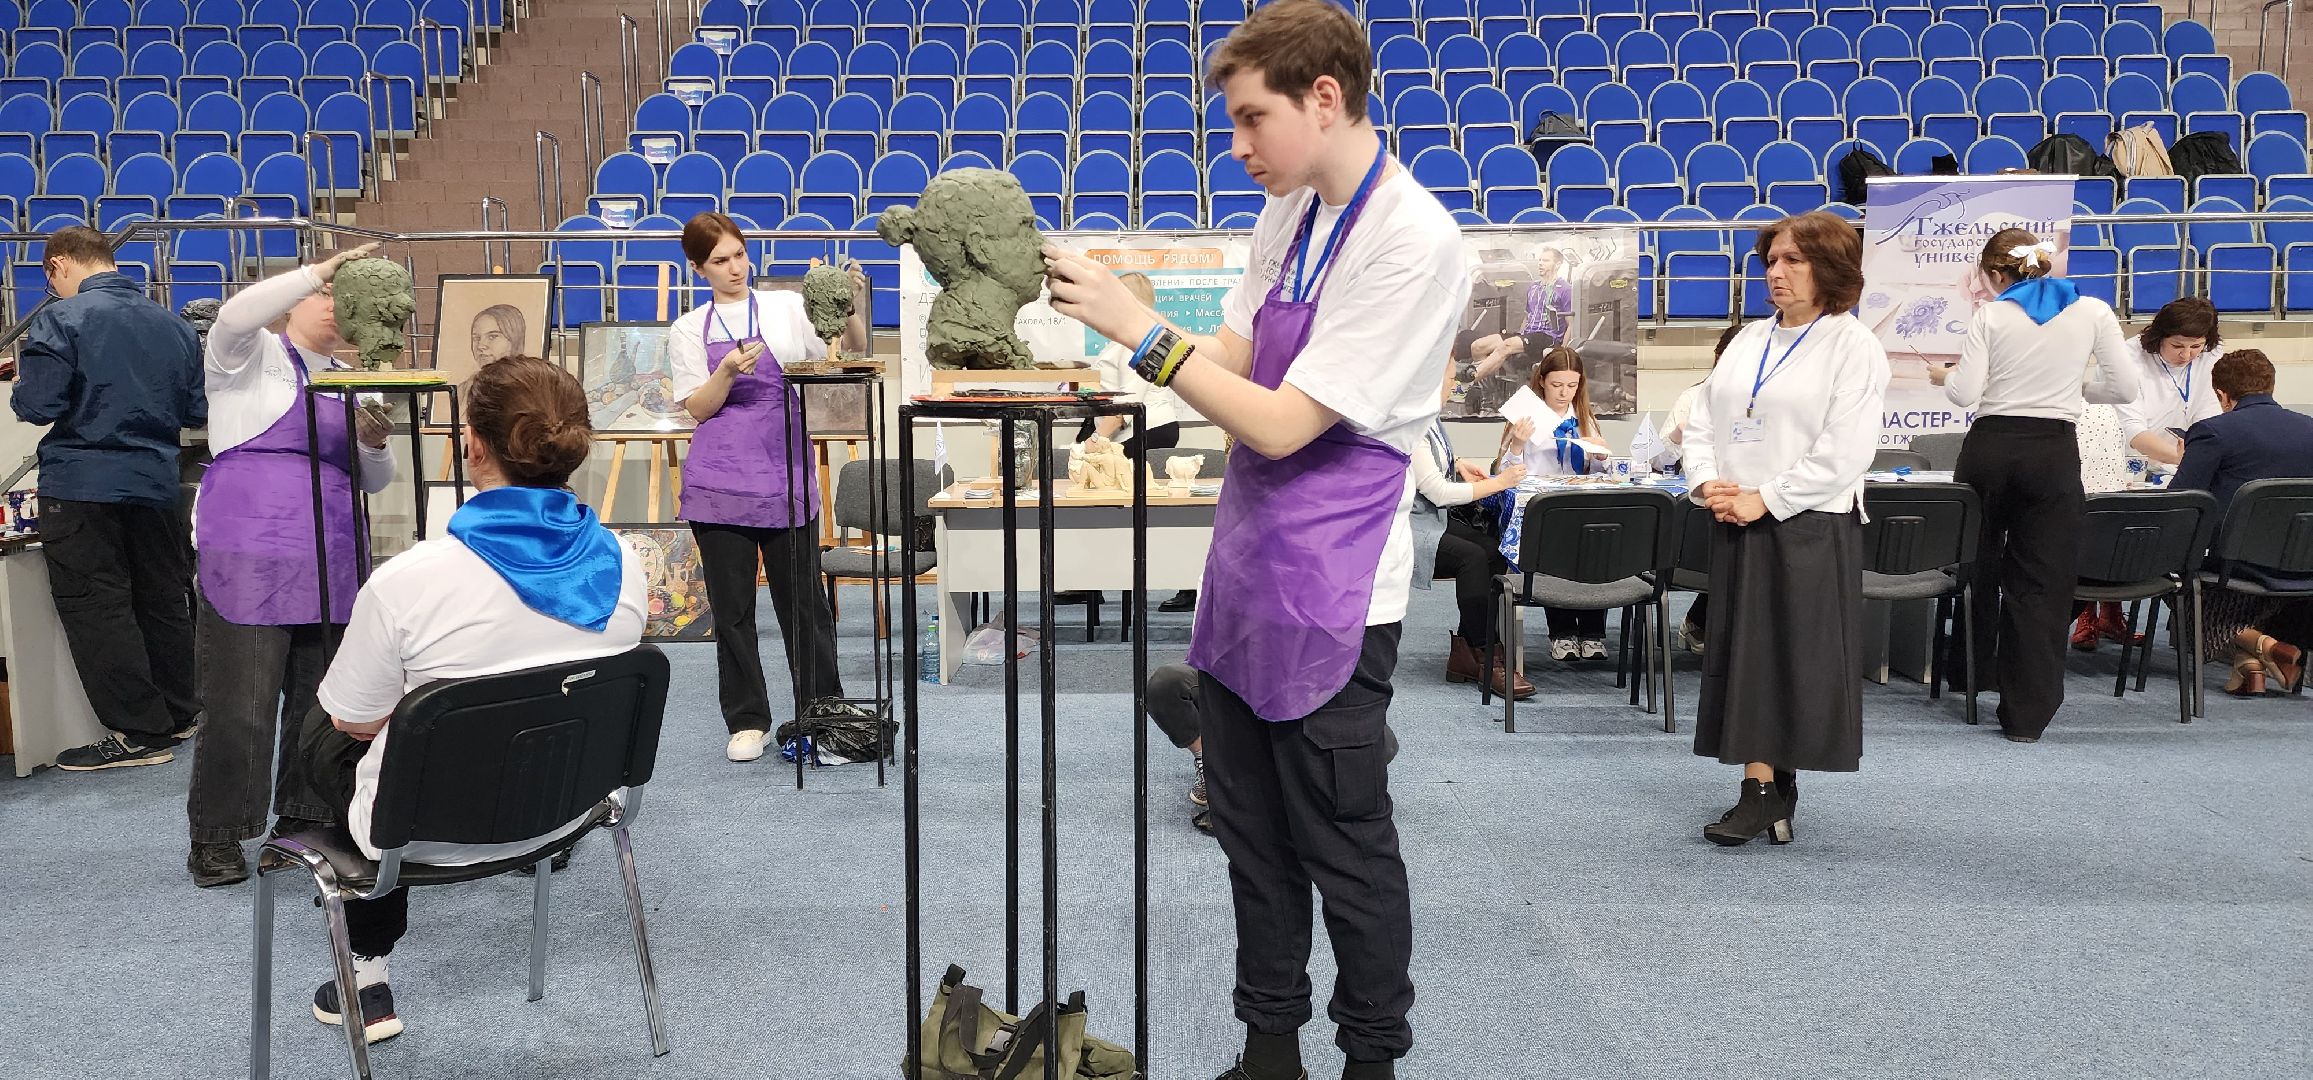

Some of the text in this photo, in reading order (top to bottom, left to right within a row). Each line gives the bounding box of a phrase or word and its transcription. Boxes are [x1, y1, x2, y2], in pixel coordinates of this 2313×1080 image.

[1093, 254, 1156, 266] ПОМОЩЬ
[1189, 277, 1219, 286] ПОСЛЕ
[1179, 293, 1213, 303] ВРАЧЕЙ
